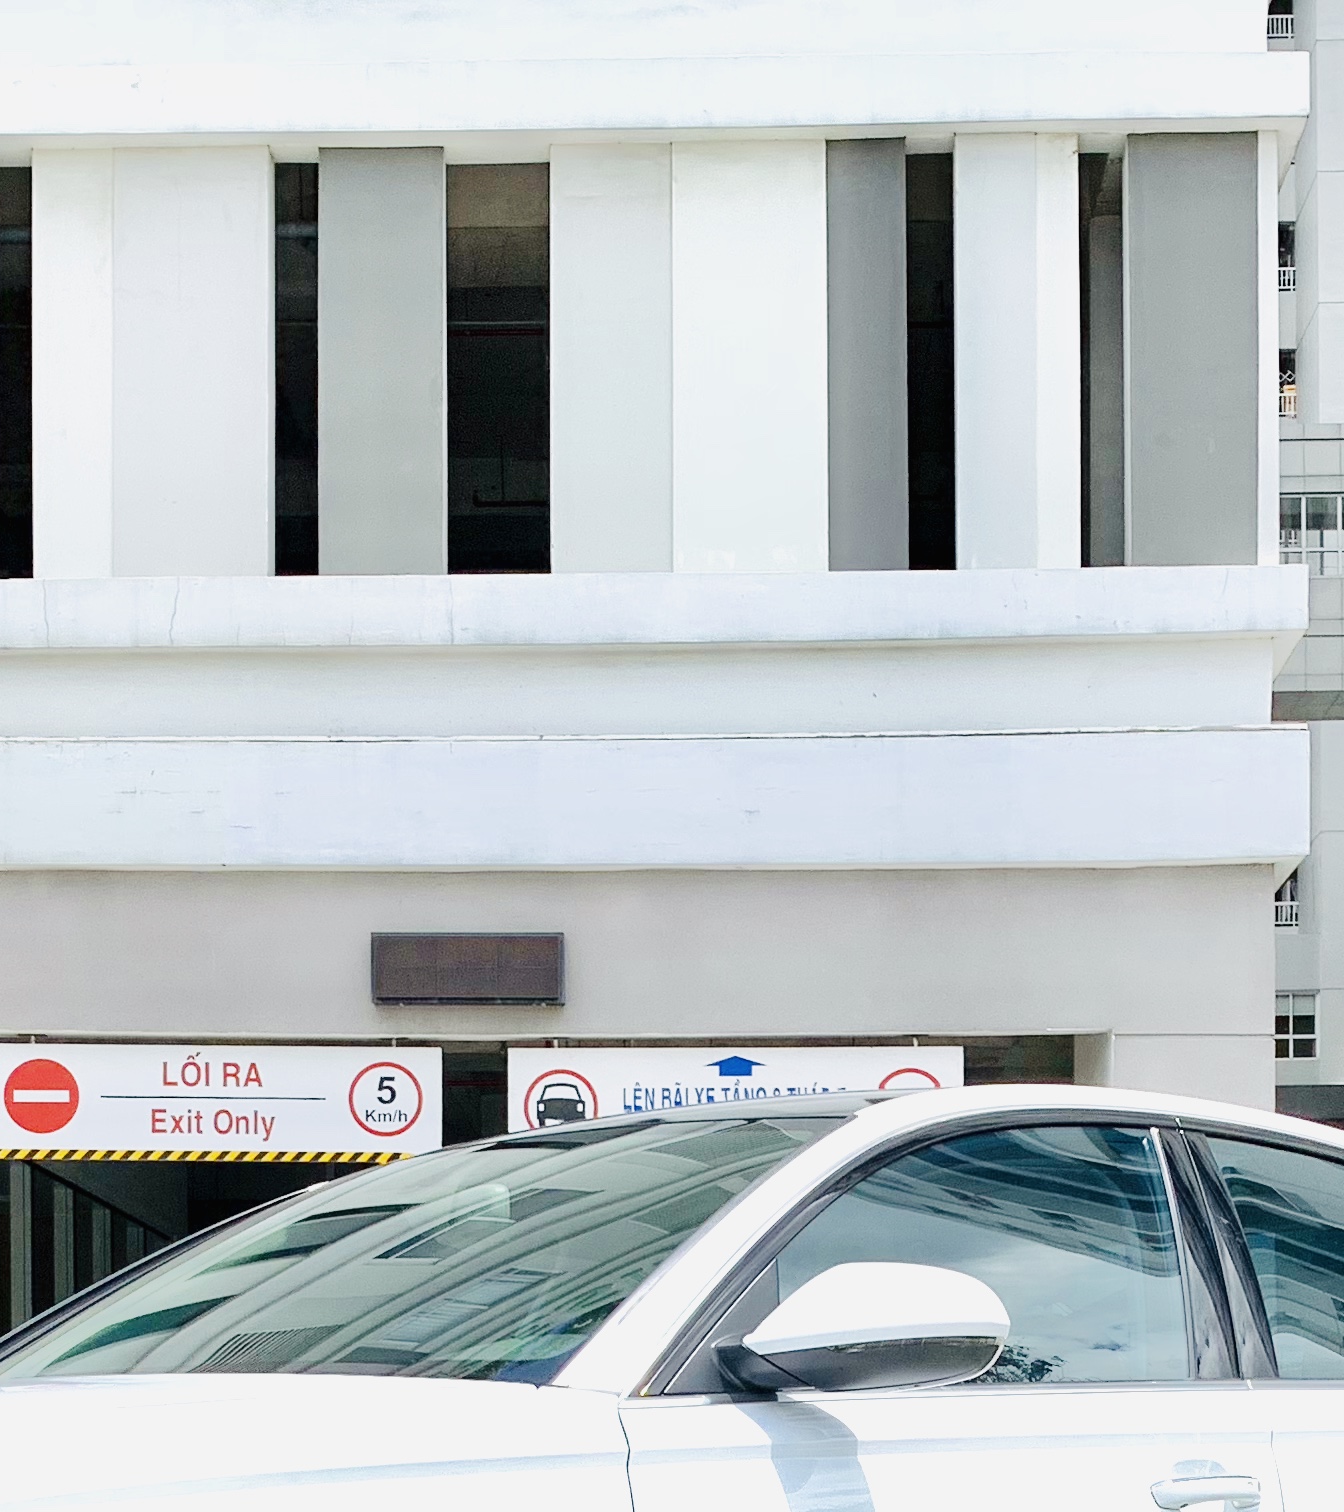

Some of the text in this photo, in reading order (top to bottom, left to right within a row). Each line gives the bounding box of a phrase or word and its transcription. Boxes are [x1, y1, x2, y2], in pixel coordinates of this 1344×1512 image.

[163, 1052, 263, 1087] LỐI RA
[376, 1076, 397, 1104] 5
[151, 1109, 275, 1141] Exit Only
[365, 1109, 408, 1123] Km/h
